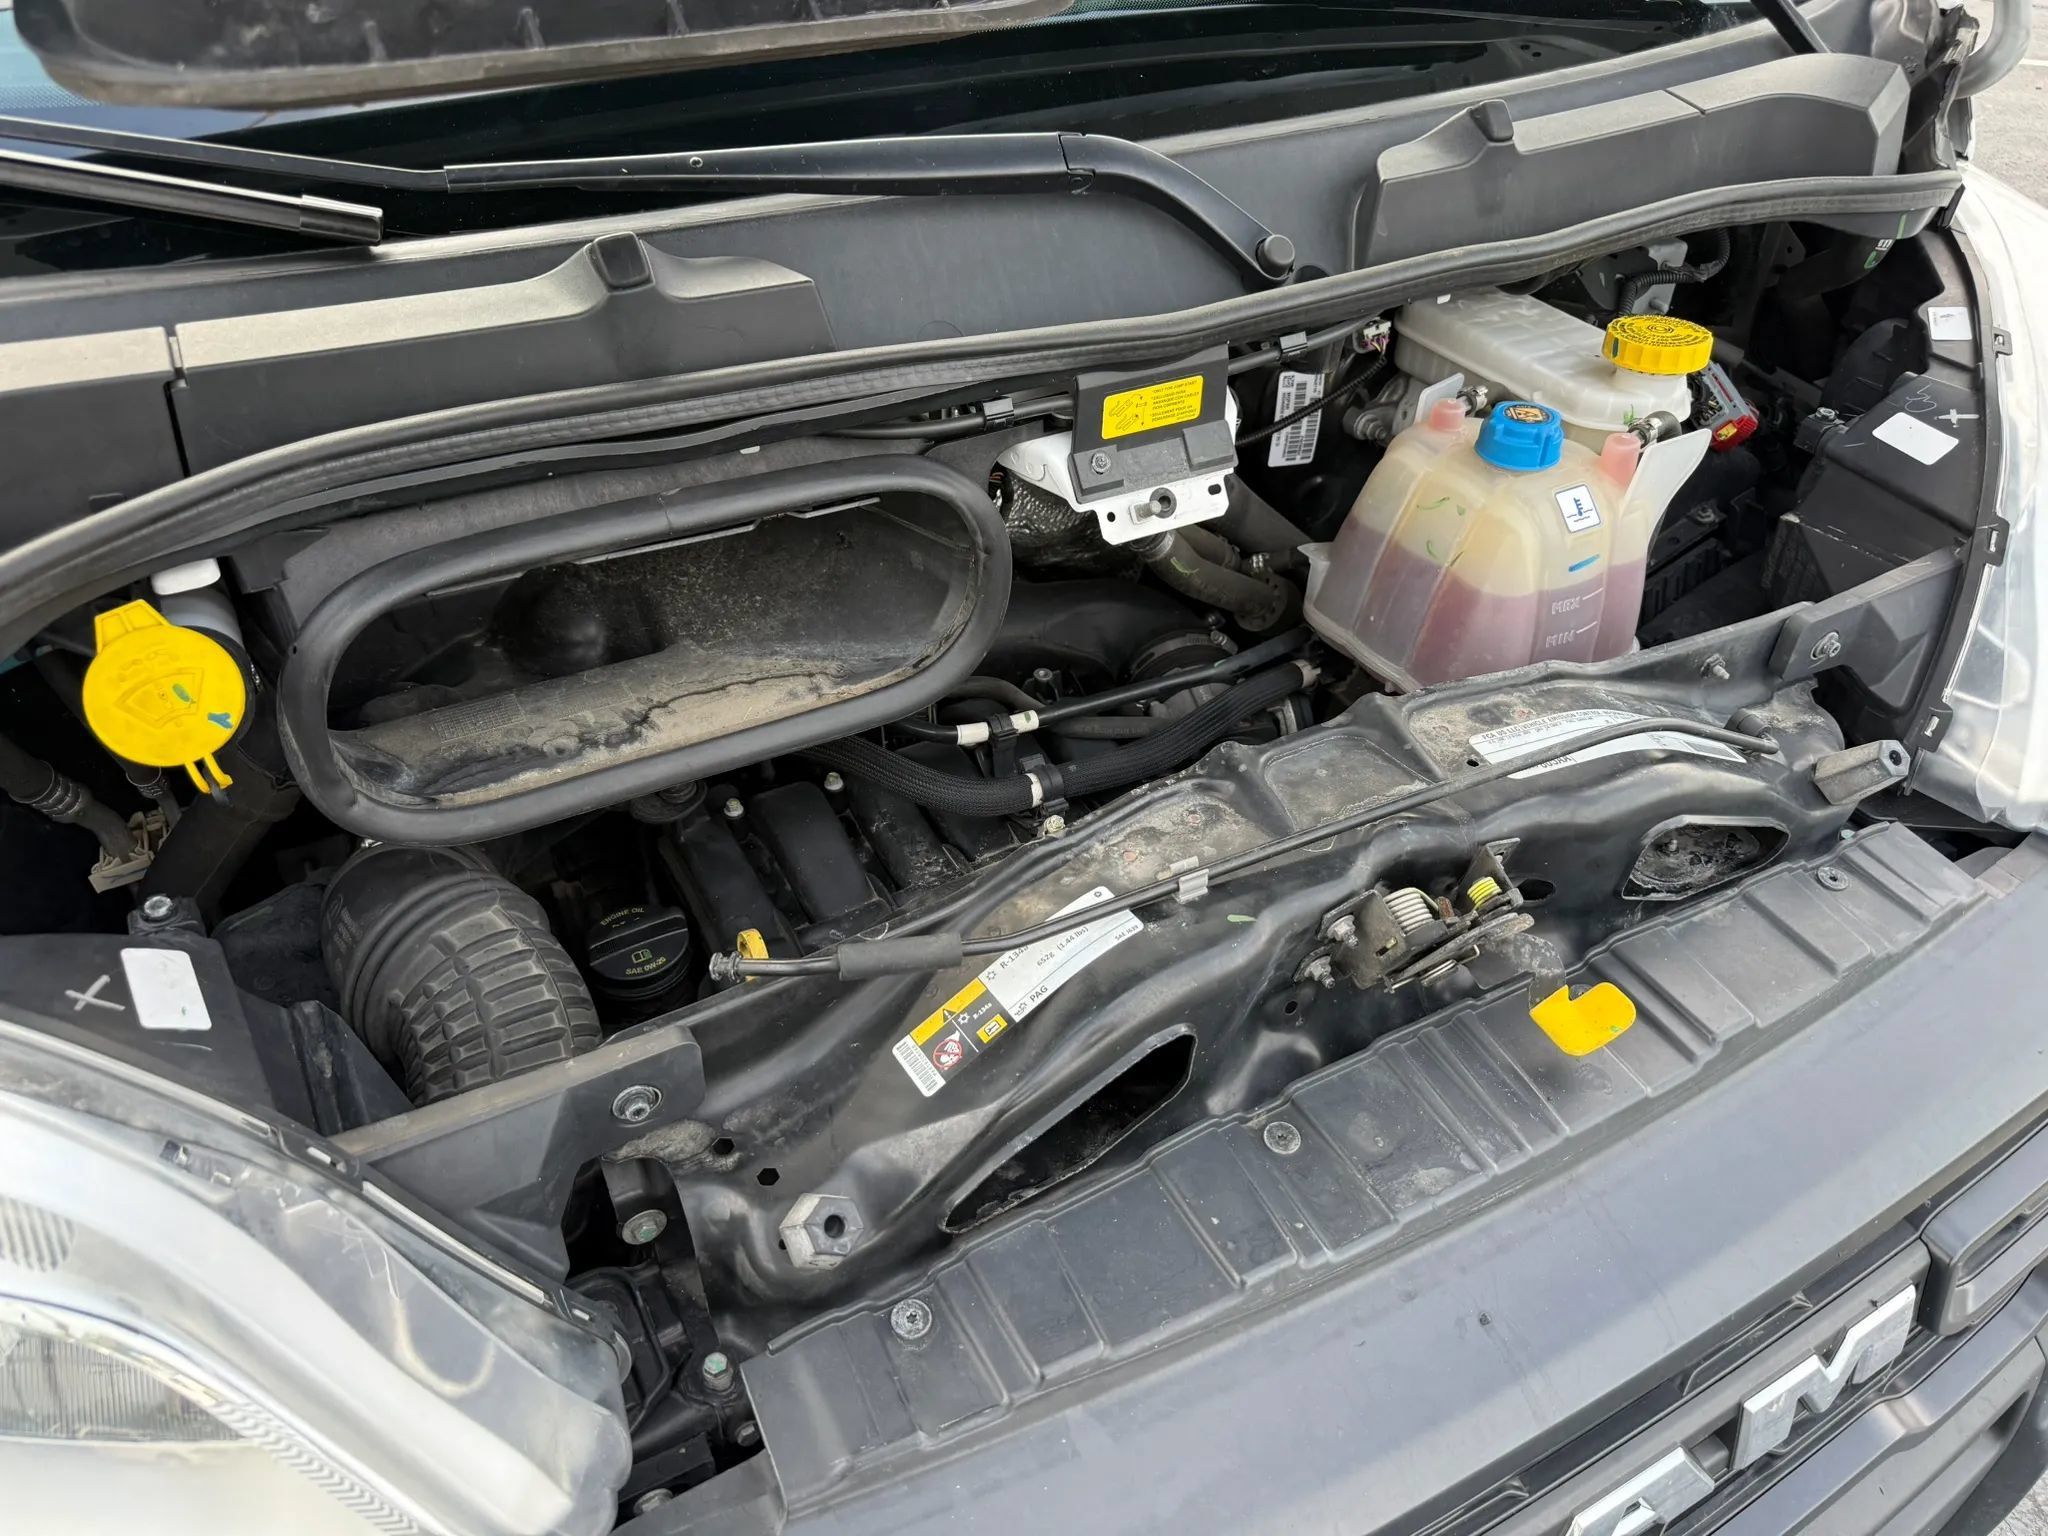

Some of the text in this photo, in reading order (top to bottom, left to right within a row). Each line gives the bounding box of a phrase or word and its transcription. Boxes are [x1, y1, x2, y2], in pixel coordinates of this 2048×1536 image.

[1551, 596, 1581, 615] MAX
[1545, 629, 1576, 648] MIN
[1482, 732, 1496, 740] FCA
[600, 909, 629, 926] ENGINE
[625, 956, 666, 976] SAE 0W-20
[1036, 952, 1055, 967] 652g
[1029, 985, 1049, 1002] PAG
